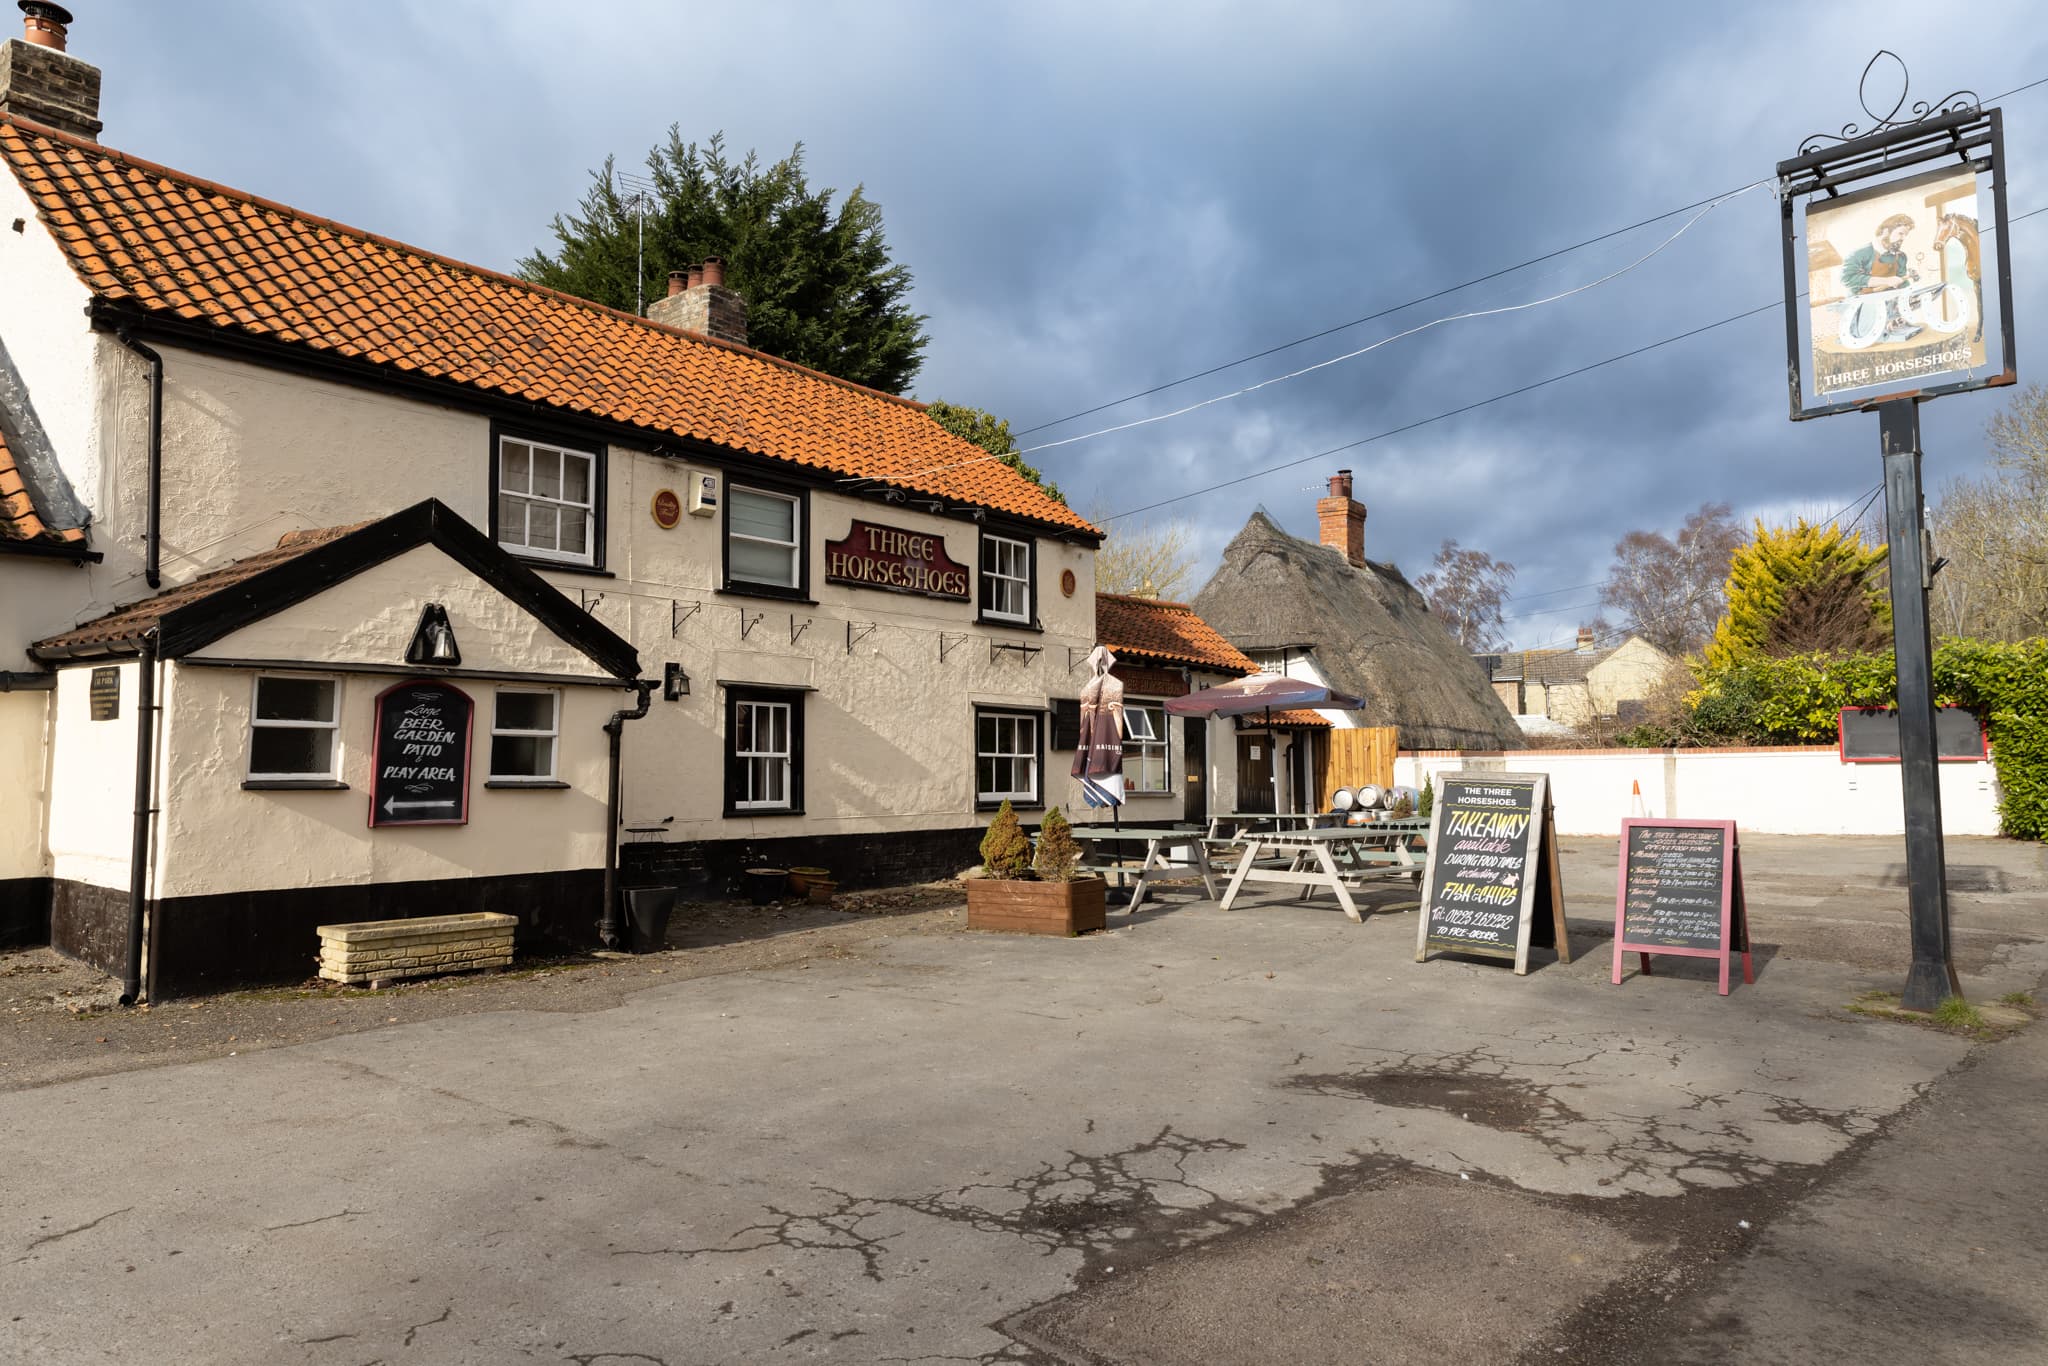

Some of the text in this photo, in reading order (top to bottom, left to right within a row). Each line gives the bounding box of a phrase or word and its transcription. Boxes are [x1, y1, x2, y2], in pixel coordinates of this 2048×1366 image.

[1823, 346, 1973, 387] THREE HORSESHOES
[864, 527, 935, 561] THREE
[831, 552, 967, 595] HORSESHOES
[404, 704, 442, 718] Large
[399, 718, 445, 731] BEER
[393, 729, 456, 745] GARDEN,
[402, 743, 442, 757] PATIO
[383, 766, 456, 782] PLAY AREA
[1464, 787, 1513, 796] THE THREE
[1457, 796, 1517, 806] HORSESHOES
[1446, 810, 1530, 840] TAKEAWAY
[1454, 838, 1511, 854] available
[1443, 853, 1523, 869] DURING FOOD TIMES
[1456, 867, 1500, 883] including
[1440, 882, 1475, 903] FISH
[1478, 885, 1519, 906] CHIPS
[1445, 909, 1474, 925] 01223
[1437, 926, 1448, 935] TO
